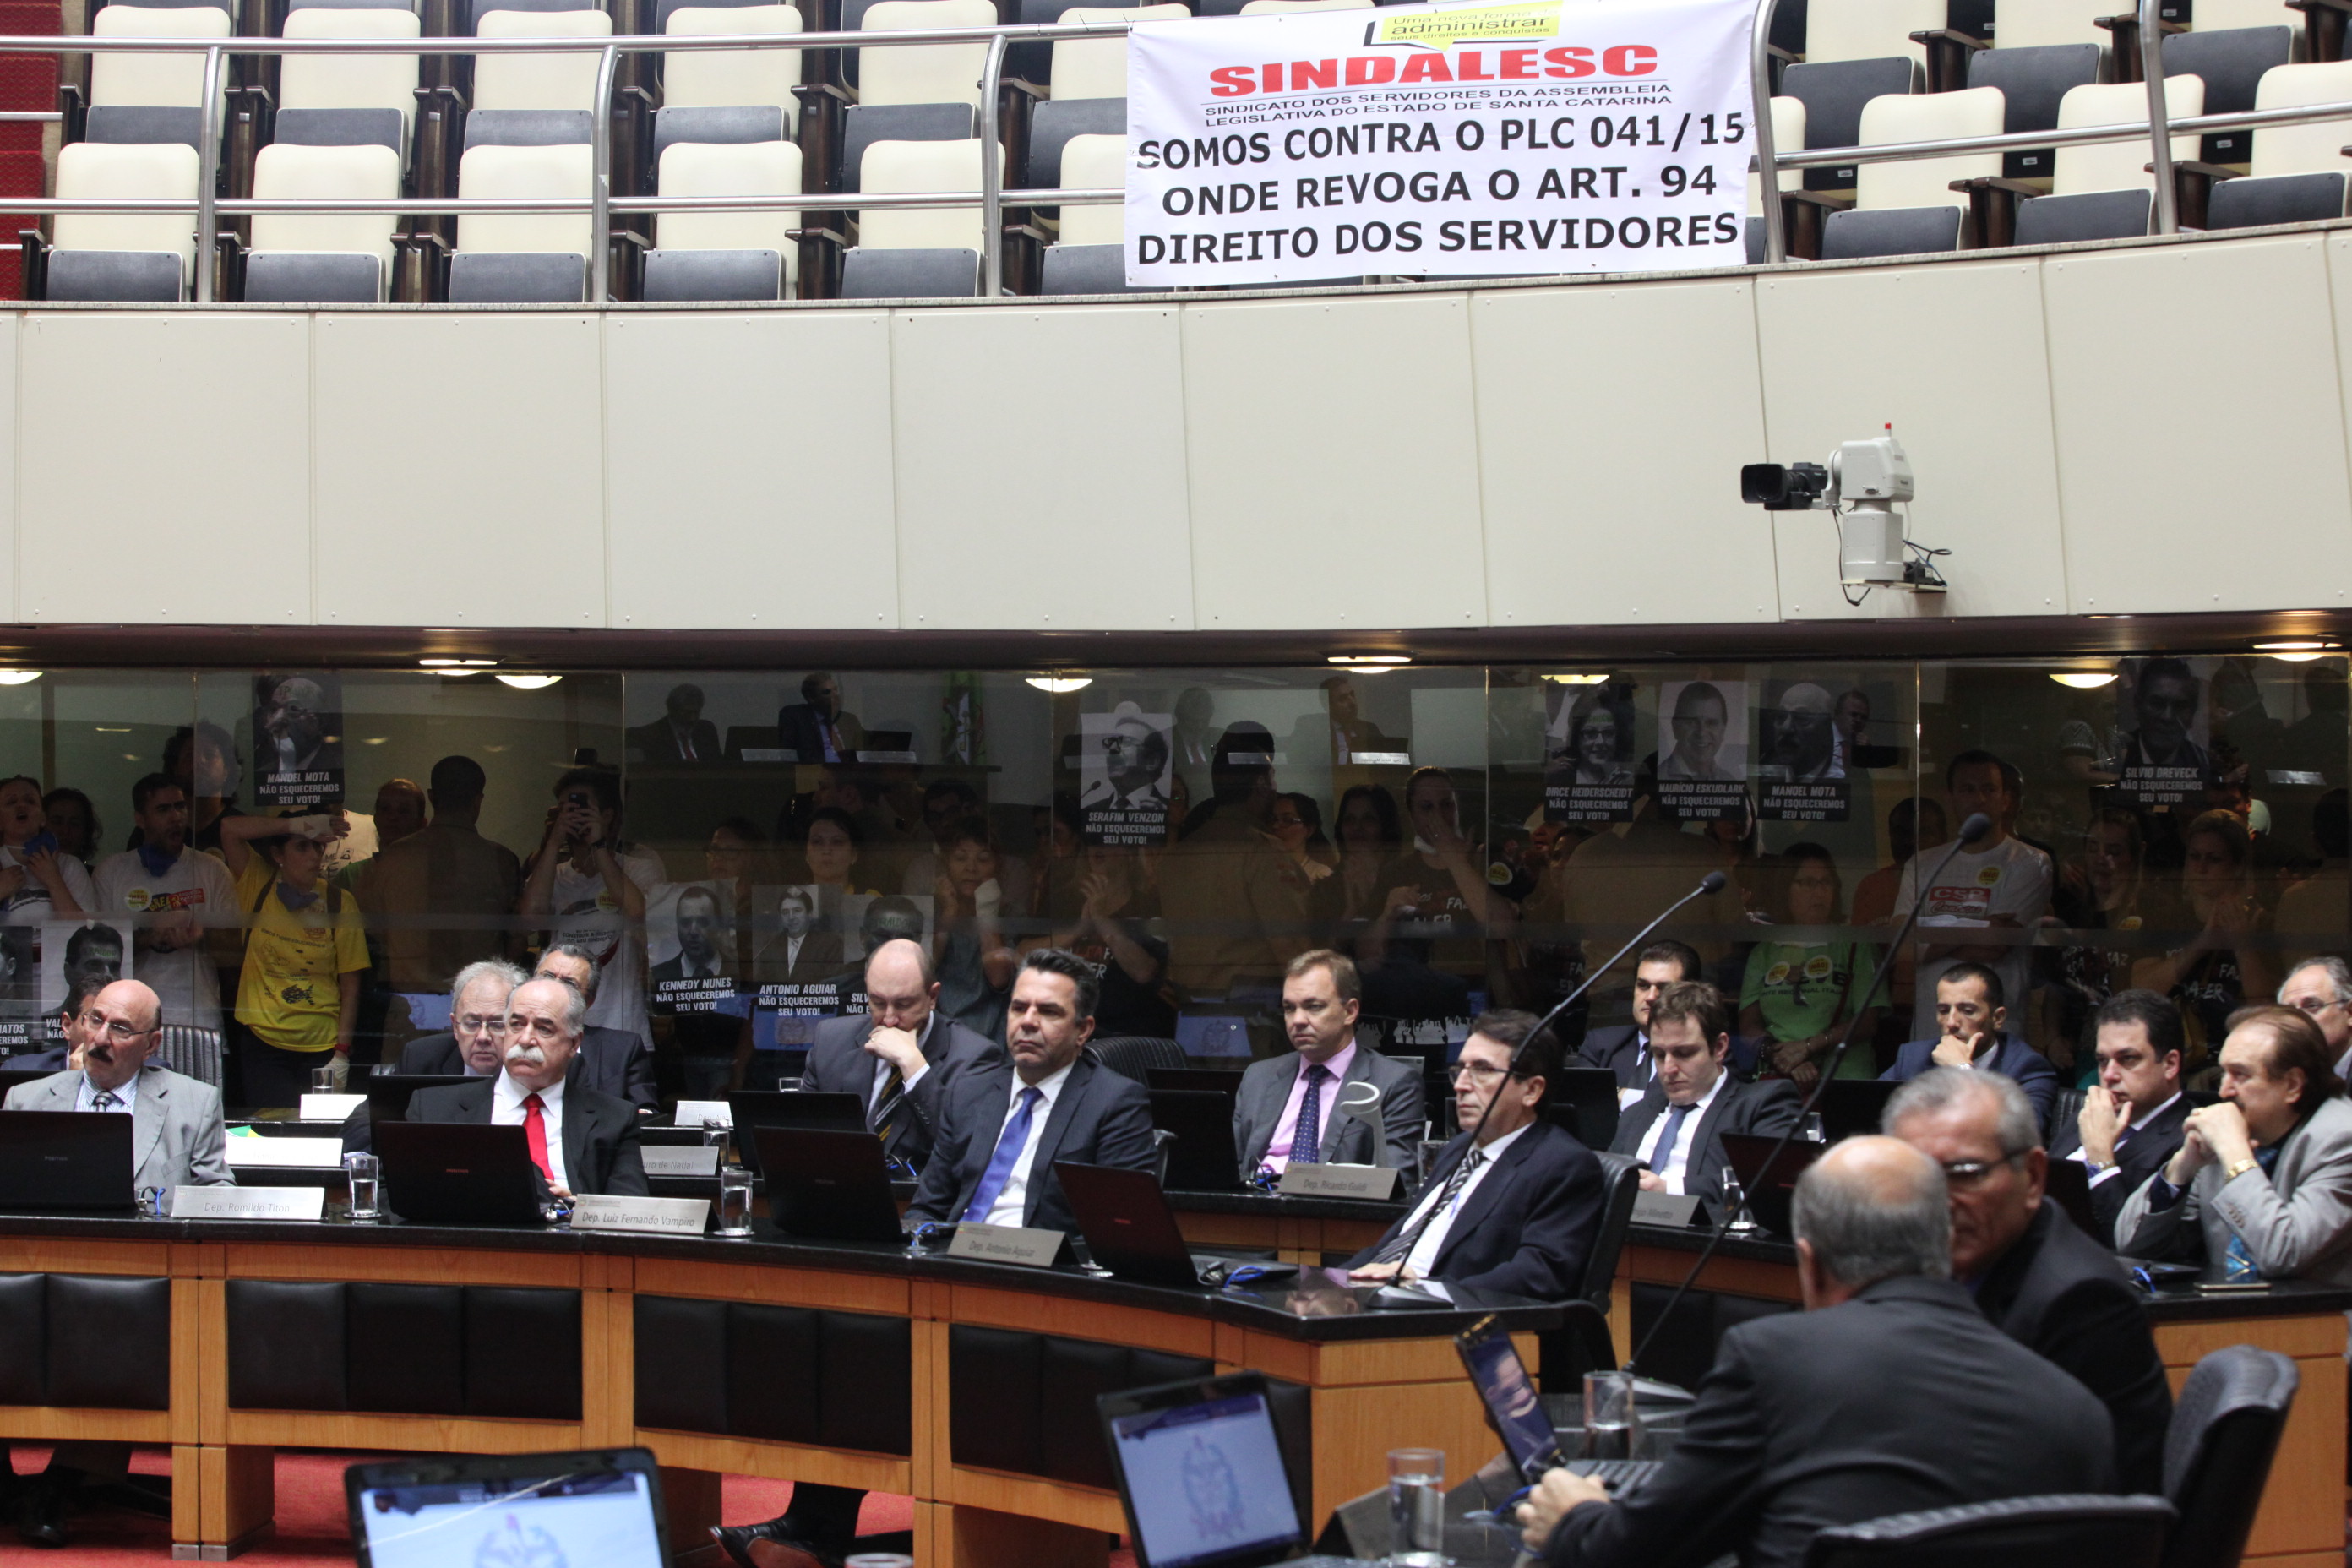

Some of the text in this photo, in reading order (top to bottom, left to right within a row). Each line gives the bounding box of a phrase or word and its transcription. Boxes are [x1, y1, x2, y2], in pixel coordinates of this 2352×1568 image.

[1484, 11, 1532, 19] forma
[1392, 18, 1550, 35] administrar
[1424, 30, 1467, 39] direitos
[1484, 27, 1550, 36] conquistas
[1209, 45, 1658, 97] SINDALESC
[1206, 84, 1673, 116] SINDICATO DOS SERVIDORES DA ASSEMBLEIA
[1206, 96, 1673, 127] LEGISLATIVA DO ESTADO DE SANTA CATARINA
[1136, 112, 1745, 170] SOMOS CONTRA O PLC 041/15
[1162, 165, 1717, 217] ONDE REVOGA O ART. 94
[1138, 212, 1739, 265] DIREITO DOS SERVIDORES
[267, 771, 330, 784] MANOEL MOTA
[2125, 766, 2199, 779] SILVIO DREVECK
[259, 783, 340, 795] NÃO ESQUECEREMOS
[1658, 781, 1745, 793] MAURÍCIO ESKUDLARK
[1772, 785, 1837, 797] MANOEL MOTA
[2120, 779, 2203, 792] NÃO ESQUECEREMOS
[1545, 787, 1634, 798] DIRCE HEIDERSCHEIDT
[2139, 792, 2184, 803] SEU VOTO!
[278, 795, 321, 804] SEU VOTO!
[1549, 798, 1629, 810] NÃO ESQUECEREMOS
[1661, 794, 1740, 807] NÃO ESQUECEREMOS
[1763, 797, 1845, 809] NÃO ESQUECEREMOS
[1088, 811, 1165, 824] SERAFIM VENZON
[1567, 811, 1610, 820] SEU VOTO!
[1678, 808, 1721, 817] SEU VOTO!
[1781, 810, 1826, 820] SEU VOTO!
[1086, 823, 1166, 835] NÃO ESQUECEREMOS
[1102, 835, 1147, 845] SEU VOTO!
[1933, 888, 1985, 902] CSP
[659, 977, 732, 992] KENNEDY NUNES
[759, 983, 837, 995] ANTONIO AGUIAR
[656, 989, 736, 1003] NÃO ESQUECEREMOS
[759, 995, 840, 1007] NÃO ESQUECEREMOS
[850, 992, 869, 1004] SILV
[675, 1001, 718, 1012] SEU VOTO!
[777, 1007, 821, 1016] SEU VOTO!
[846, 1004, 863, 1014] NÃO
[46, 1018, 63, 1028] VAL
[46, 1028, 65, 1039] NÃO
[658, 1161, 668, 1170] de
[671, 1161, 694, 1170] Nadal
[204, 1202, 291, 1213] Dep. Romildo Titon
[581, 1211, 695, 1228] Dep. Luiz Fernando Vampiro
